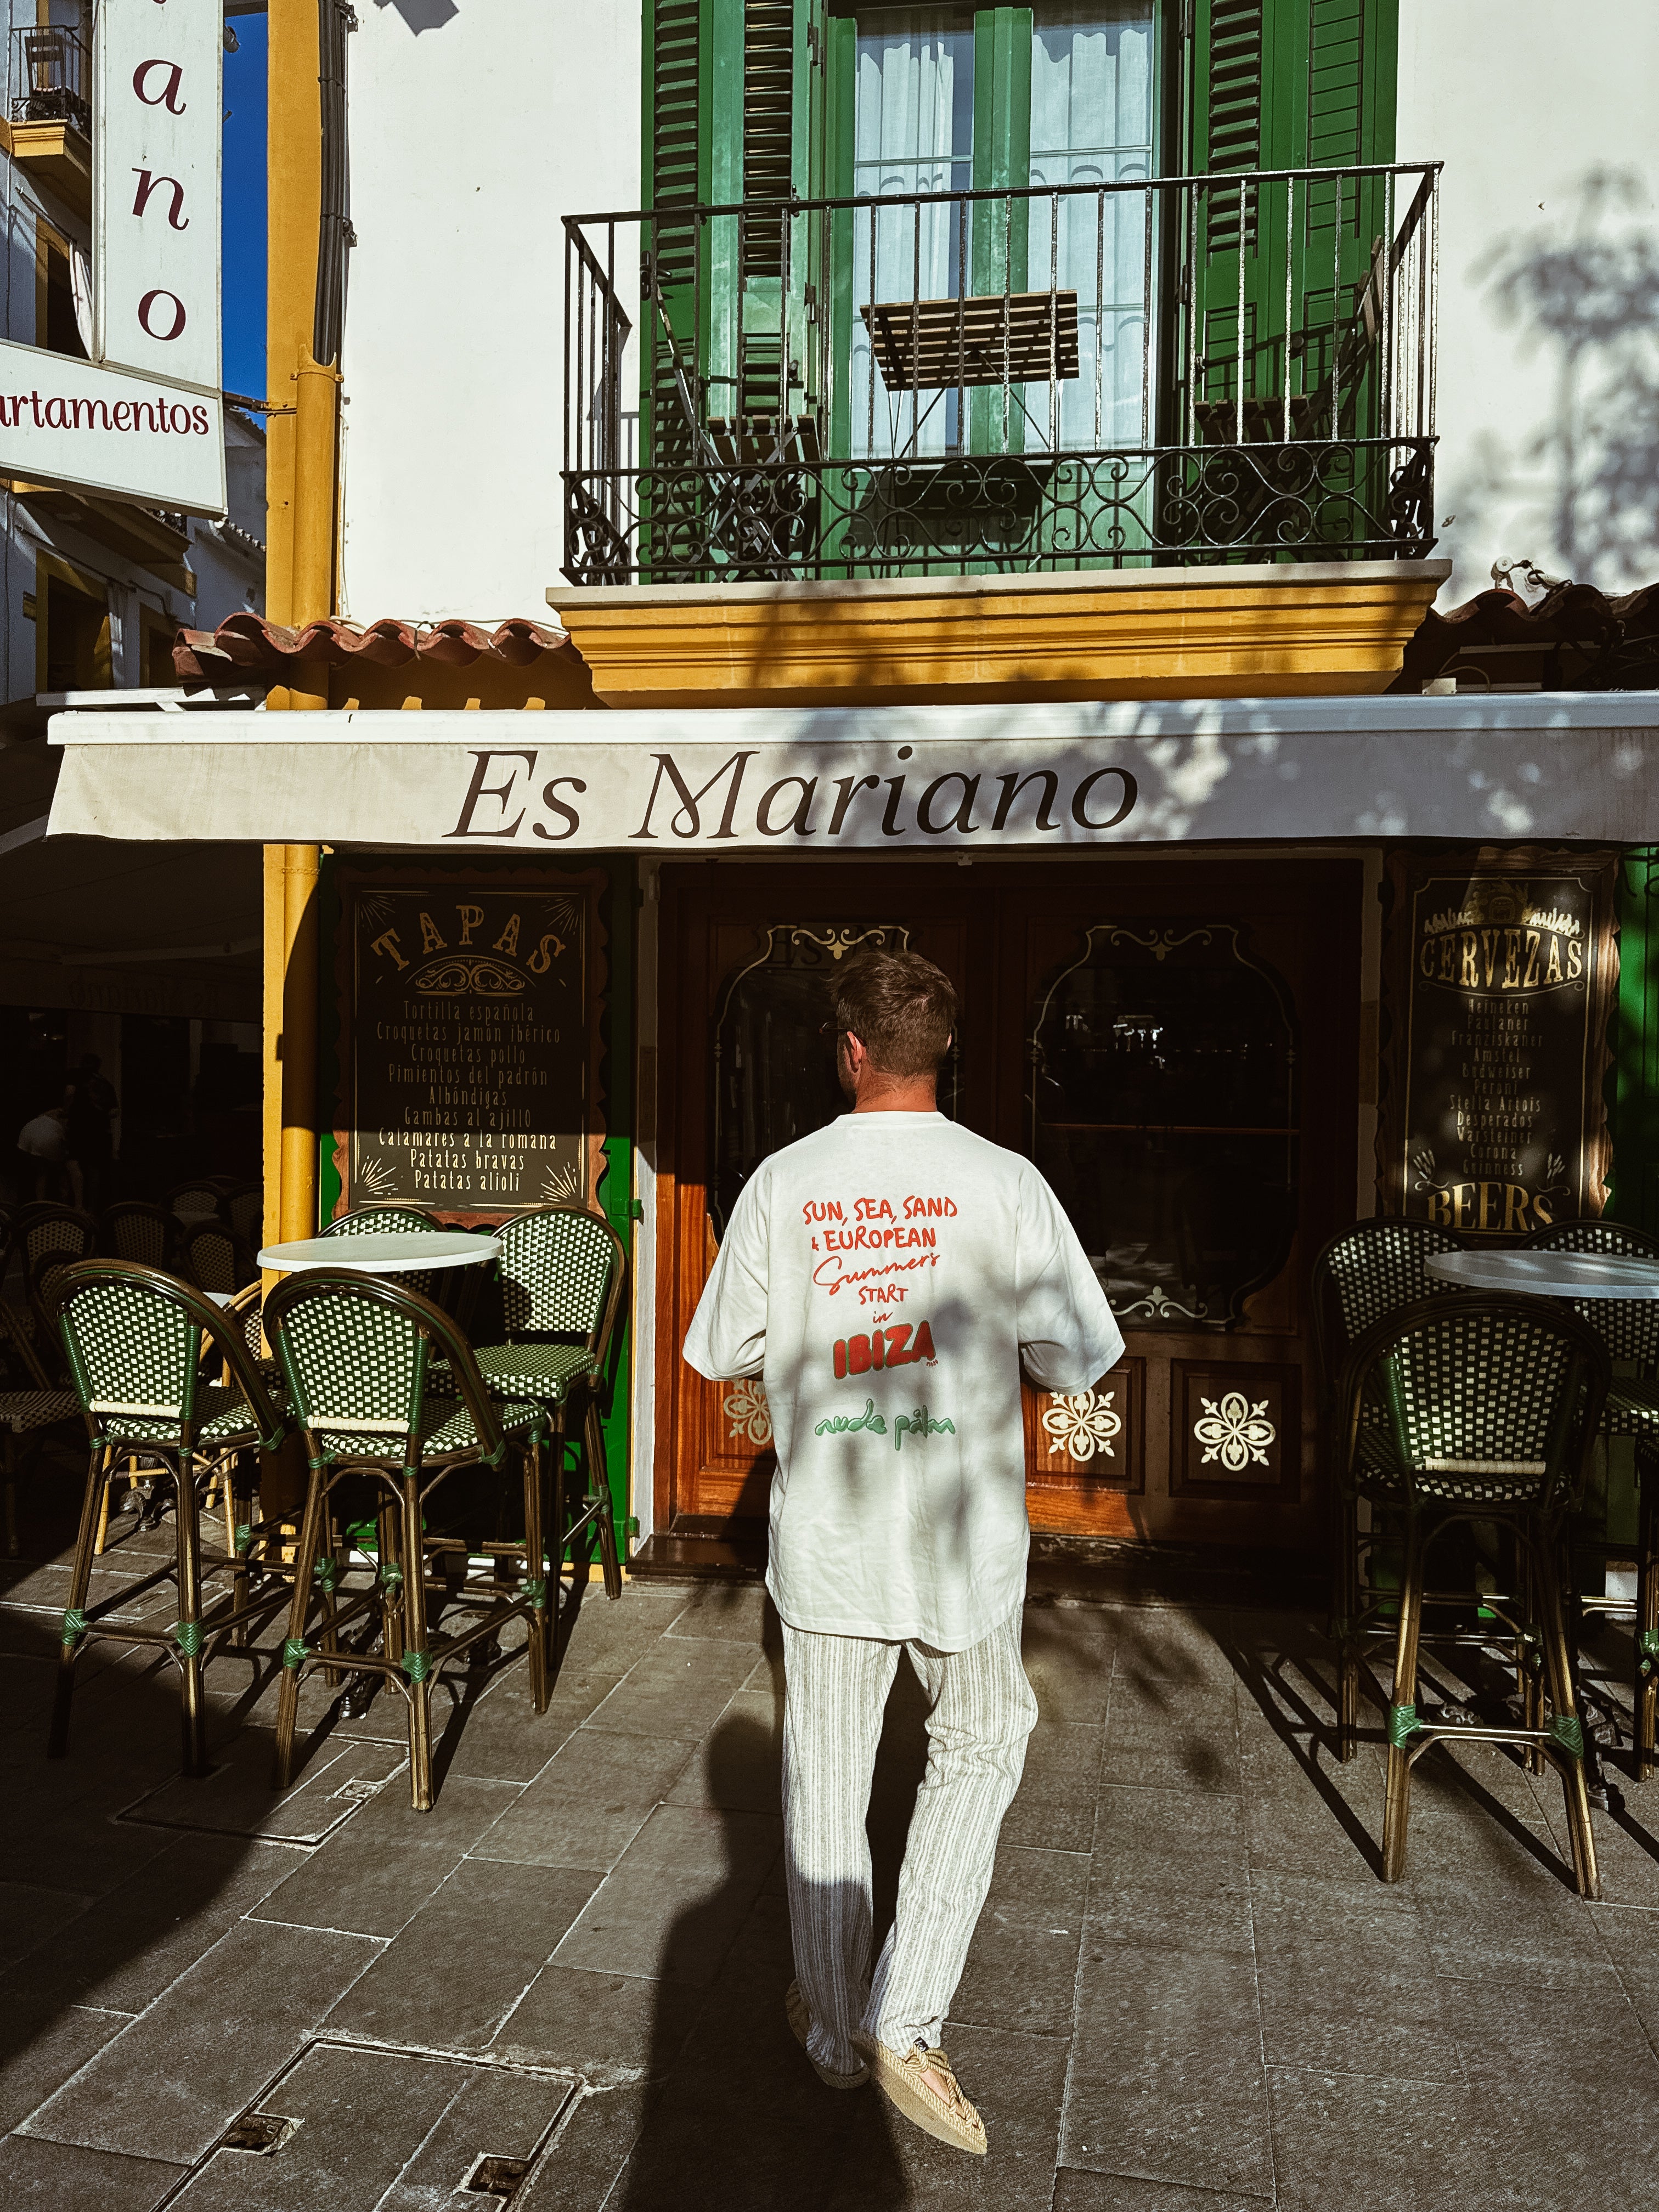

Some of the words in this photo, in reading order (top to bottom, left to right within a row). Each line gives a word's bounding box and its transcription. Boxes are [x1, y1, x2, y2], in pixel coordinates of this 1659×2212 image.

[441, 749, 588, 840] Es
[628, 746, 1138, 840] Mariano
[370, 904, 566, 974] TAPAS
[1420, 928, 1583, 990] CERVEZAS
[404, 1001, 460, 1020] Tortilla
[470, 1003, 534, 1025] española
[1468, 998, 1529, 1014] Heineken
[377, 1022, 447, 1045] Croquetas
[457, 1023, 501, 1045] jamón
[511, 1024, 560, 1043] ibérico
[1467, 1014, 1528, 1031] Paulaner
[1451, 1030, 1543, 1047] Franziskaner
[411, 1043, 481, 1066] Croquetas
[491, 1045, 525, 1068] pollo
[1474, 1047, 1520, 1063] Amstel
[389, 1064, 460, 1084] Pimientos
[469, 1066, 489, 1084] del
[499, 1066, 548, 1089] padrón
[1462, 1062, 1531, 1080] Budweiser
[430, 1086, 507, 1109] Albóndigas
[1474, 1079, 1518, 1095] Peroni
[1449, 1094, 1490, 1111] Stella
[1499, 1096, 1541, 1112] Artois
[404, 1107, 458, 1126] Gambas
[467, 1108, 480, 1126] al
[1457, 1110, 1532, 1130] Desperados
[379, 1127, 455, 1148] Calamares
[464, 1132, 470, 1148] a
[479, 1130, 492, 1148] la
[502, 1133, 556, 1150] romana
[1457, 1126, 1532, 1144] Warsteiner
[410, 1148, 466, 1169] Patatas
[476, 1150, 524, 1170] bravas
[1470, 1143, 1516, 1159] Corona
[1463, 1158, 1523, 1176] Guinness
[415, 1170, 471, 1190] Patatas
[480, 1172, 520, 1192] alioli
[803, 1200, 848, 1226] SUN,
[854, 1198, 897, 1224] SEA,
[903, 1195, 958, 1218] SAND
[1427, 1181, 1554, 1231] BEERS
[823, 1226, 936, 1251] EUROPEAN
[813, 1252, 940, 1295] Summers
[859, 1283, 909, 1305] START
[873, 1311, 893, 1323] in
[833, 1320, 936, 1380] IBIZA
